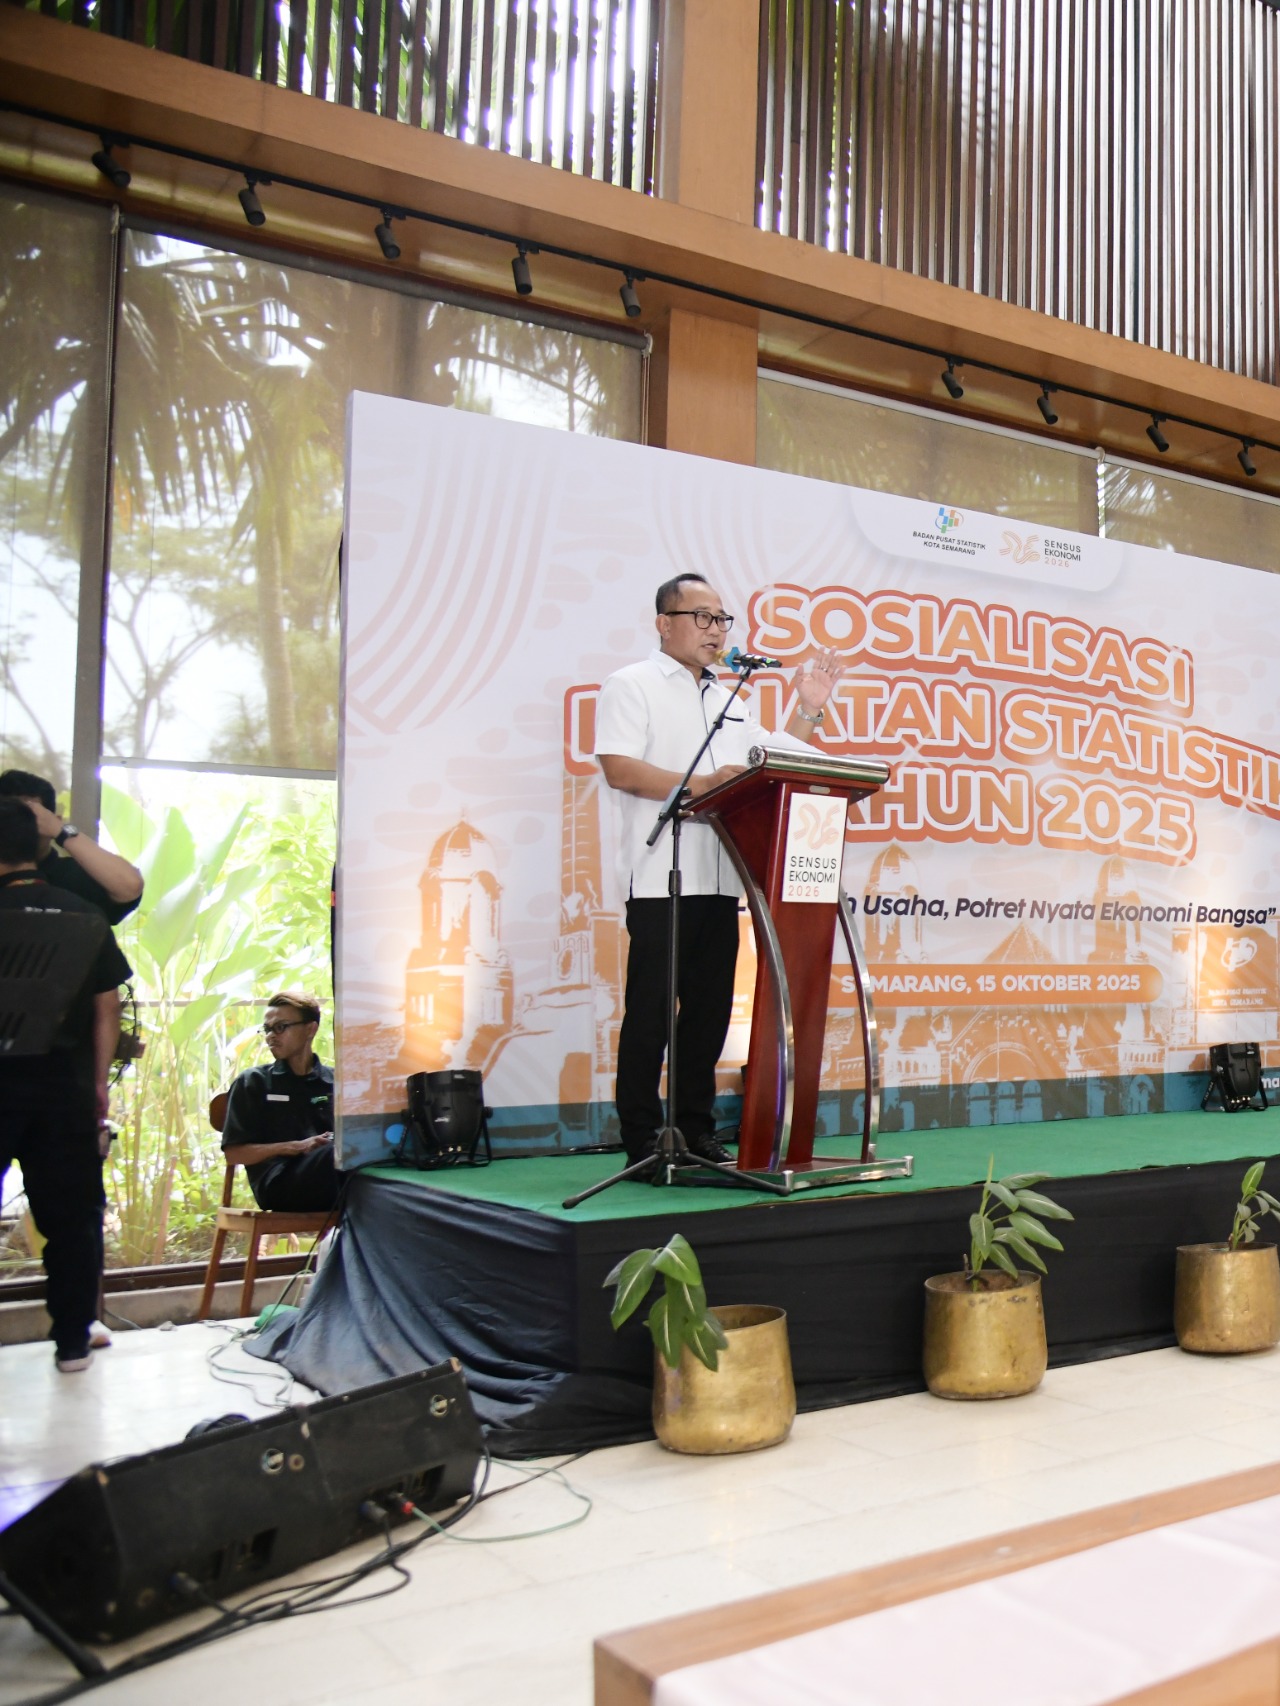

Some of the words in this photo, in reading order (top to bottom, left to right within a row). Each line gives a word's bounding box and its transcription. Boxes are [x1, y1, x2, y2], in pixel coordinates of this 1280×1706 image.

[912, 531, 935, 541] BADAN
[936, 535, 956, 544] PUSAT
[956, 538, 986, 550] STATISTIK
[1044, 539, 1082, 553] SENSUS
[923, 541, 941, 550] KOTA
[941, 544, 976, 556] SEMARANG
[1044, 548, 1082, 562] EKONOMI
[1044, 556, 1071, 568] 2026
[753, 591, 1192, 705] SOSIALISASI
[1043, 780, 1192, 854] 2025
[790, 855, 837, 869] SENSUS
[788, 870, 836, 884] EKONOMI
[787, 885, 820, 897] 2026
[863, 895, 949, 920] Usaha,
[954, 897, 1027, 919] Potret
[1030, 900, 1096, 924] Nyata
[1100, 902, 1193, 924] Ekonomi
[841, 974, 972, 994] SMARANG,
[976, 974, 996, 992] 15
[1001, 974, 1092, 992] OKTOBER
[1096, 974, 1141, 992] 2025
